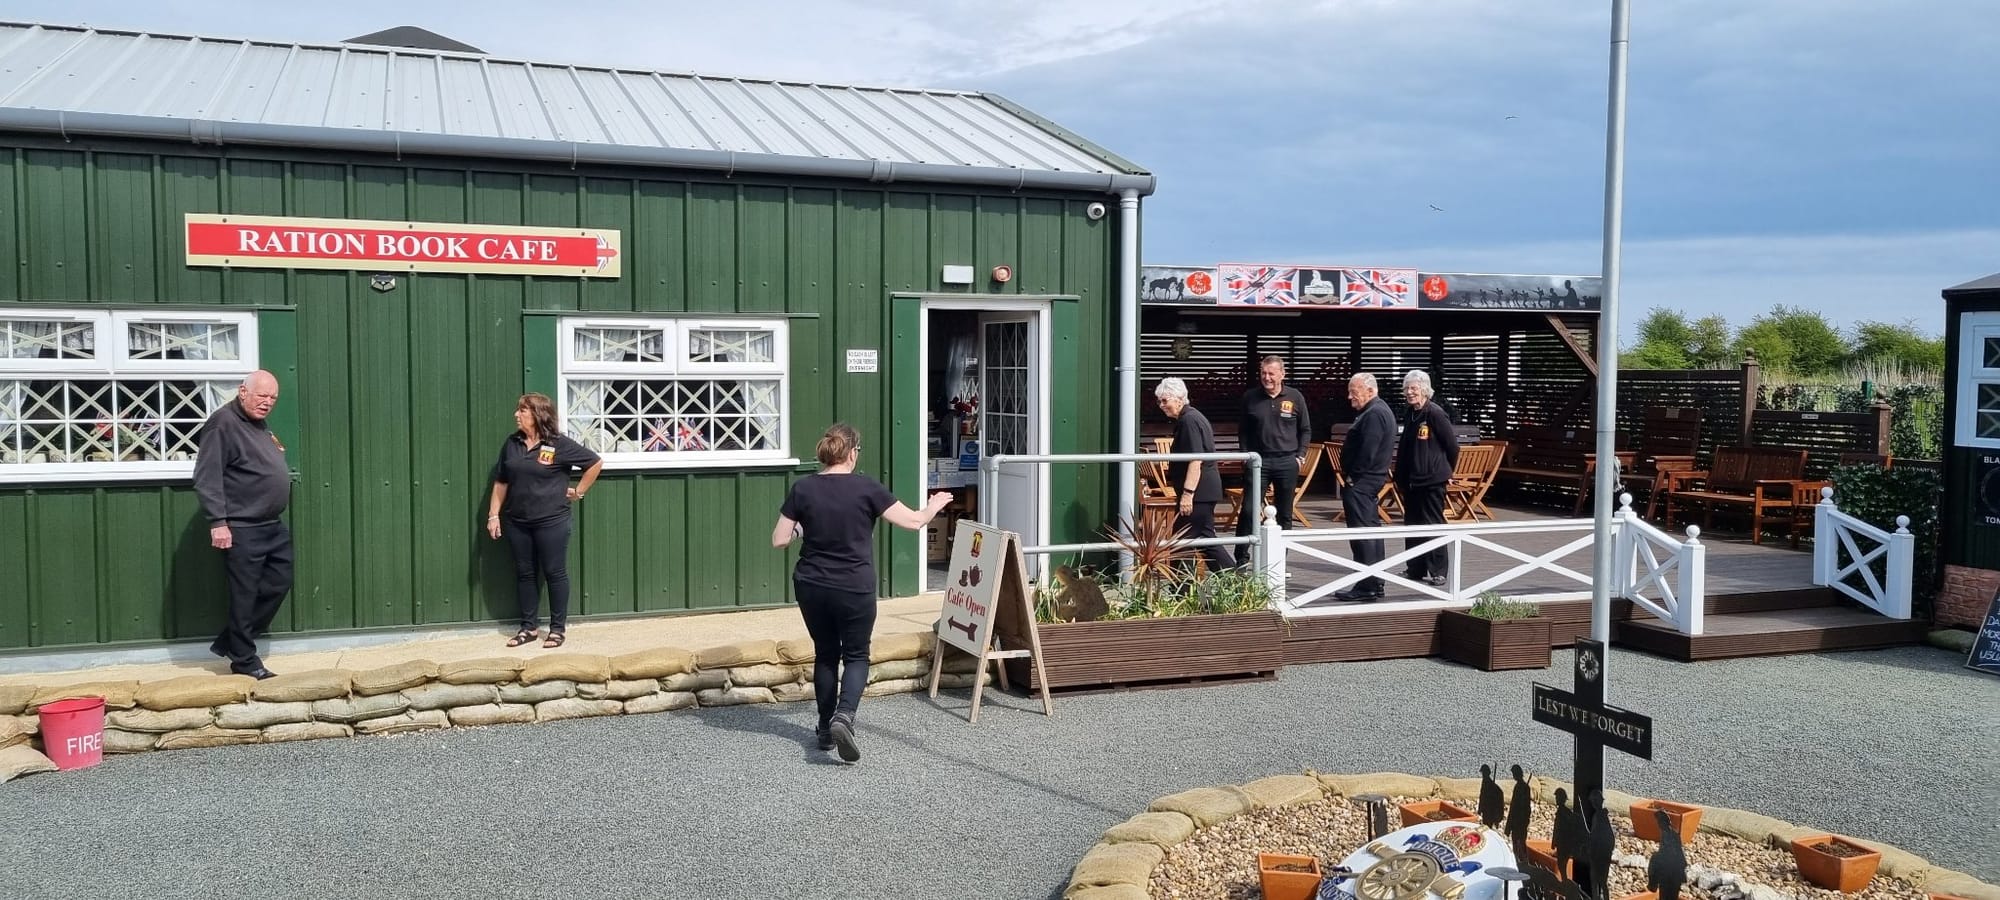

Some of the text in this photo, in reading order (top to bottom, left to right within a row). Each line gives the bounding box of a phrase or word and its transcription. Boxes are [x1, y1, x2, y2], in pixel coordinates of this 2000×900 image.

[237, 229, 559, 262] RATION BOOK CAFE
[947, 587, 986, 617] Café Open
[1538, 695, 1645, 743] LEST WE FORGET
[66, 731, 102, 756] FIRE
[1411, 841, 1461, 873] UBIQUE
